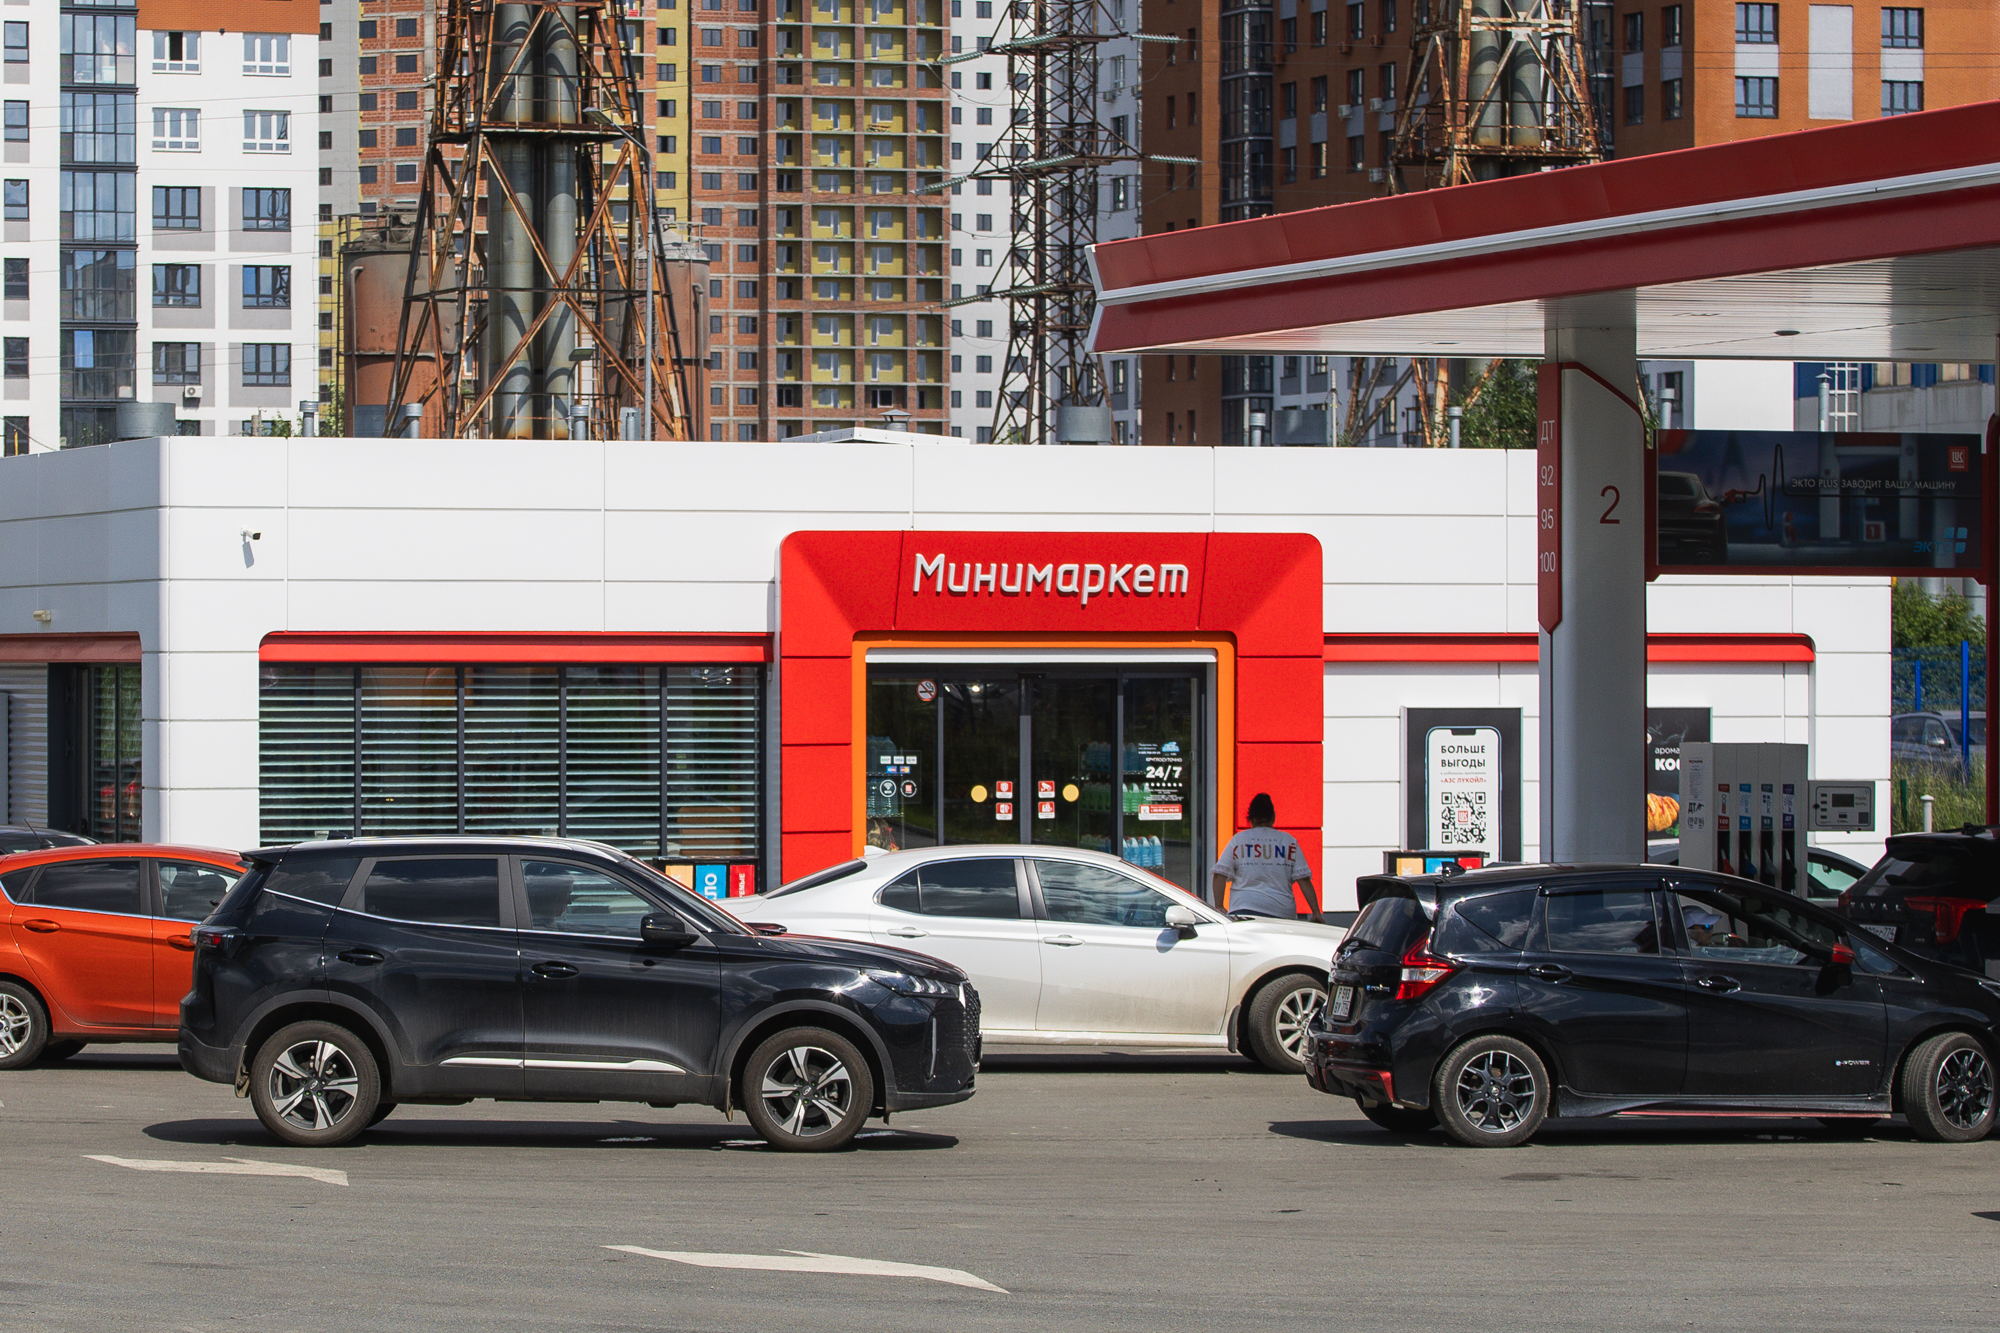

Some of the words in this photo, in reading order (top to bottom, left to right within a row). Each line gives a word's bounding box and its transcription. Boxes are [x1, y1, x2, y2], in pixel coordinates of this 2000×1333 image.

[1540, 420, 1555, 445] ДТ
[1541, 465, 1554, 486] 92
[1792, 479, 1816, 488] ЭКТО
[1818, 479, 1839, 488] PLUS
[1841, 480, 1882, 490] ЗАВОДИТ
[1885, 480, 1911, 489] ВАШУ
[1914, 481, 1957, 490] МАШИНУ
[1599, 485, 1621, 525] 2
[1541, 508, 1554, 529] 95
[1539, 551, 1556, 573] 100
[913, 553, 1189, 606] Минимаркет
[1441, 745, 1486, 754] БОЛЬШЕ
[1655, 747, 1680, 755] арома
[1146, 765, 1182, 781] 24/7
[1441, 759, 1486, 769] ВЫГОДЫ
[704, 873, 718, 900] ЛО
